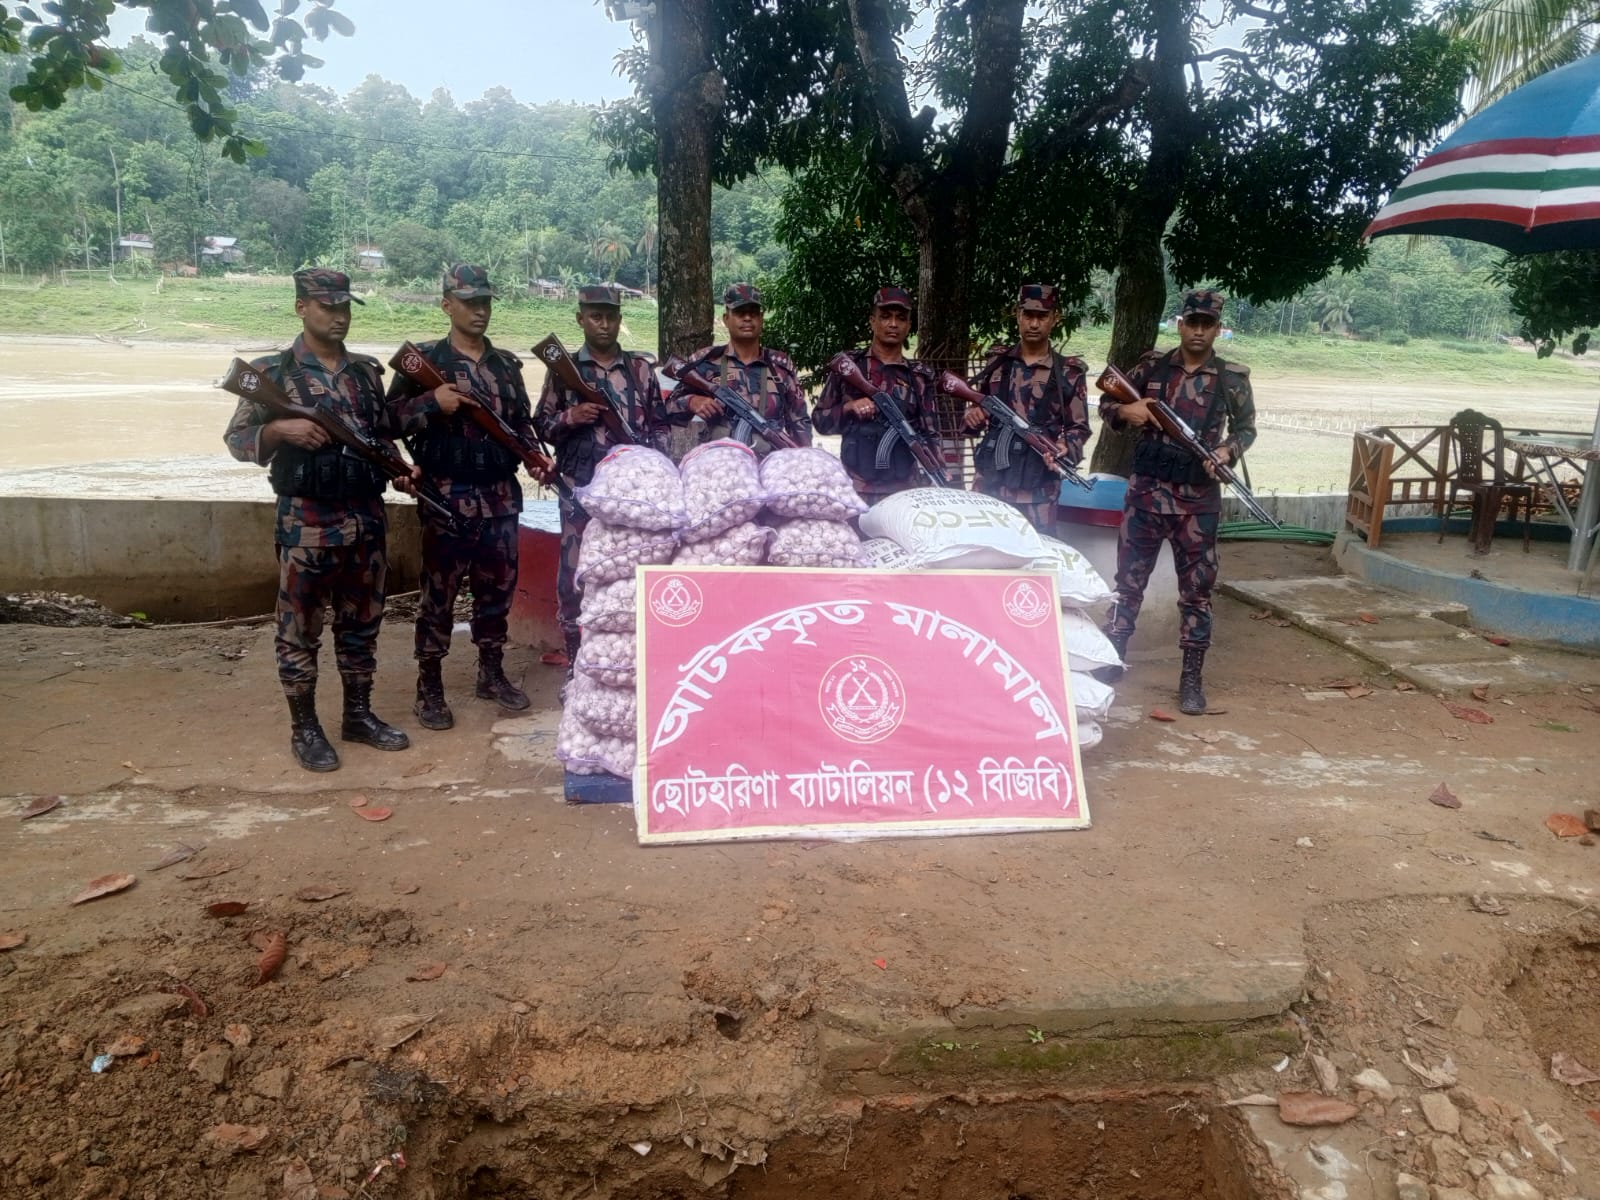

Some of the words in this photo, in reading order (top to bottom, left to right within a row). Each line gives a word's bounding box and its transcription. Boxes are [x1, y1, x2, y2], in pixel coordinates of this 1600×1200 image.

[884, 600, 1068, 744] মালামাল
[652, 763, 780, 817] ছোটহরিণা
[785, 760, 914, 808] ব্যাটালিয়ন
[923, 764, 974, 812] (১২
[976, 756, 1072, 810] বিজিবি)
